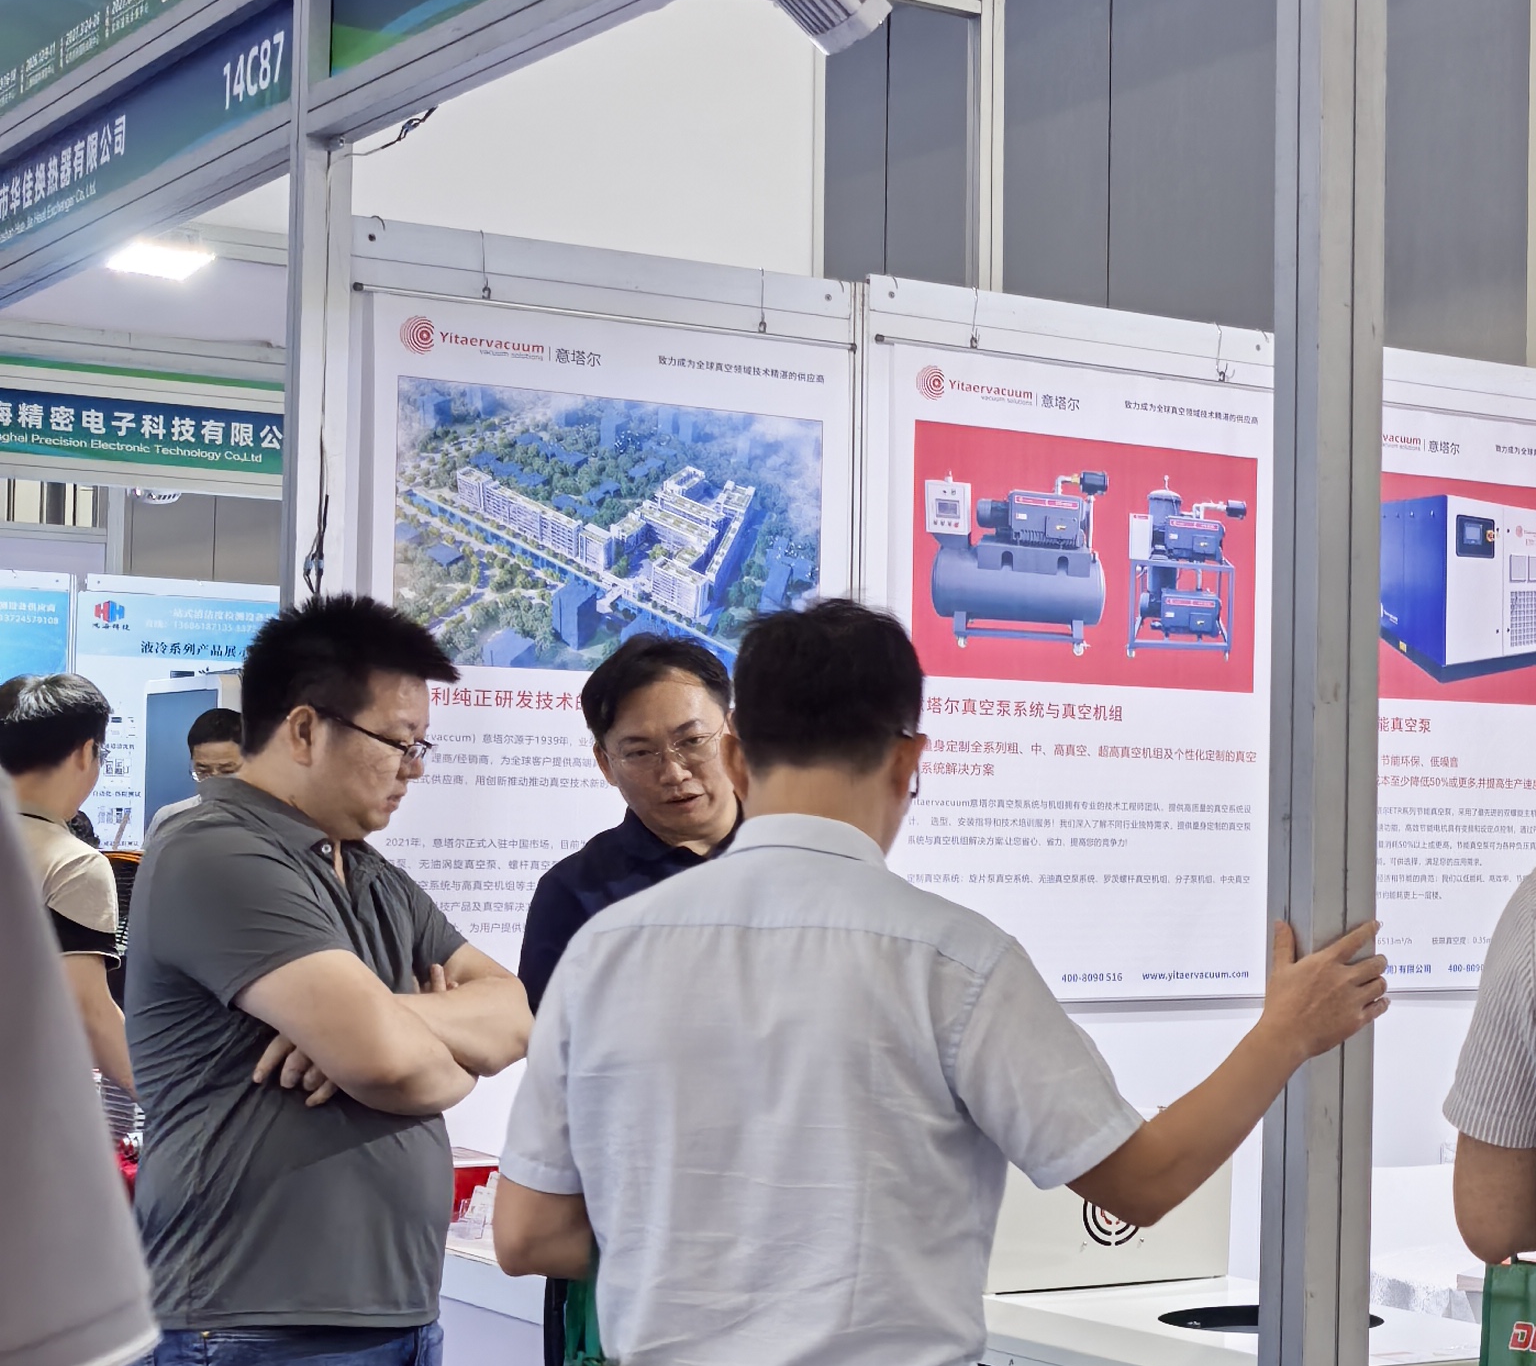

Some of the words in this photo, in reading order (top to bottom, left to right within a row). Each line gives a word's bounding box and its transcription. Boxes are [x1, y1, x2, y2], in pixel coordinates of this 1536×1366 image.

[223, 30, 285, 111] 14C87
[439, 330, 545, 355] Yitaervacuum
[555, 348, 602, 368] 意塔尔
[949, 378, 1034, 401] Yitaervacuum
[1041, 393, 1081, 411] 意塔尔
[31, 434, 87, 449] Precision
[91, 440, 150, 453] Electronic
[155, 444, 221, 461] Technology
[1428, 440, 1460, 455] 意塔尔
[921, 761, 995, 777] 系统解决方案
[1142, 970, 1249, 982] www.yitaervacuum.com
